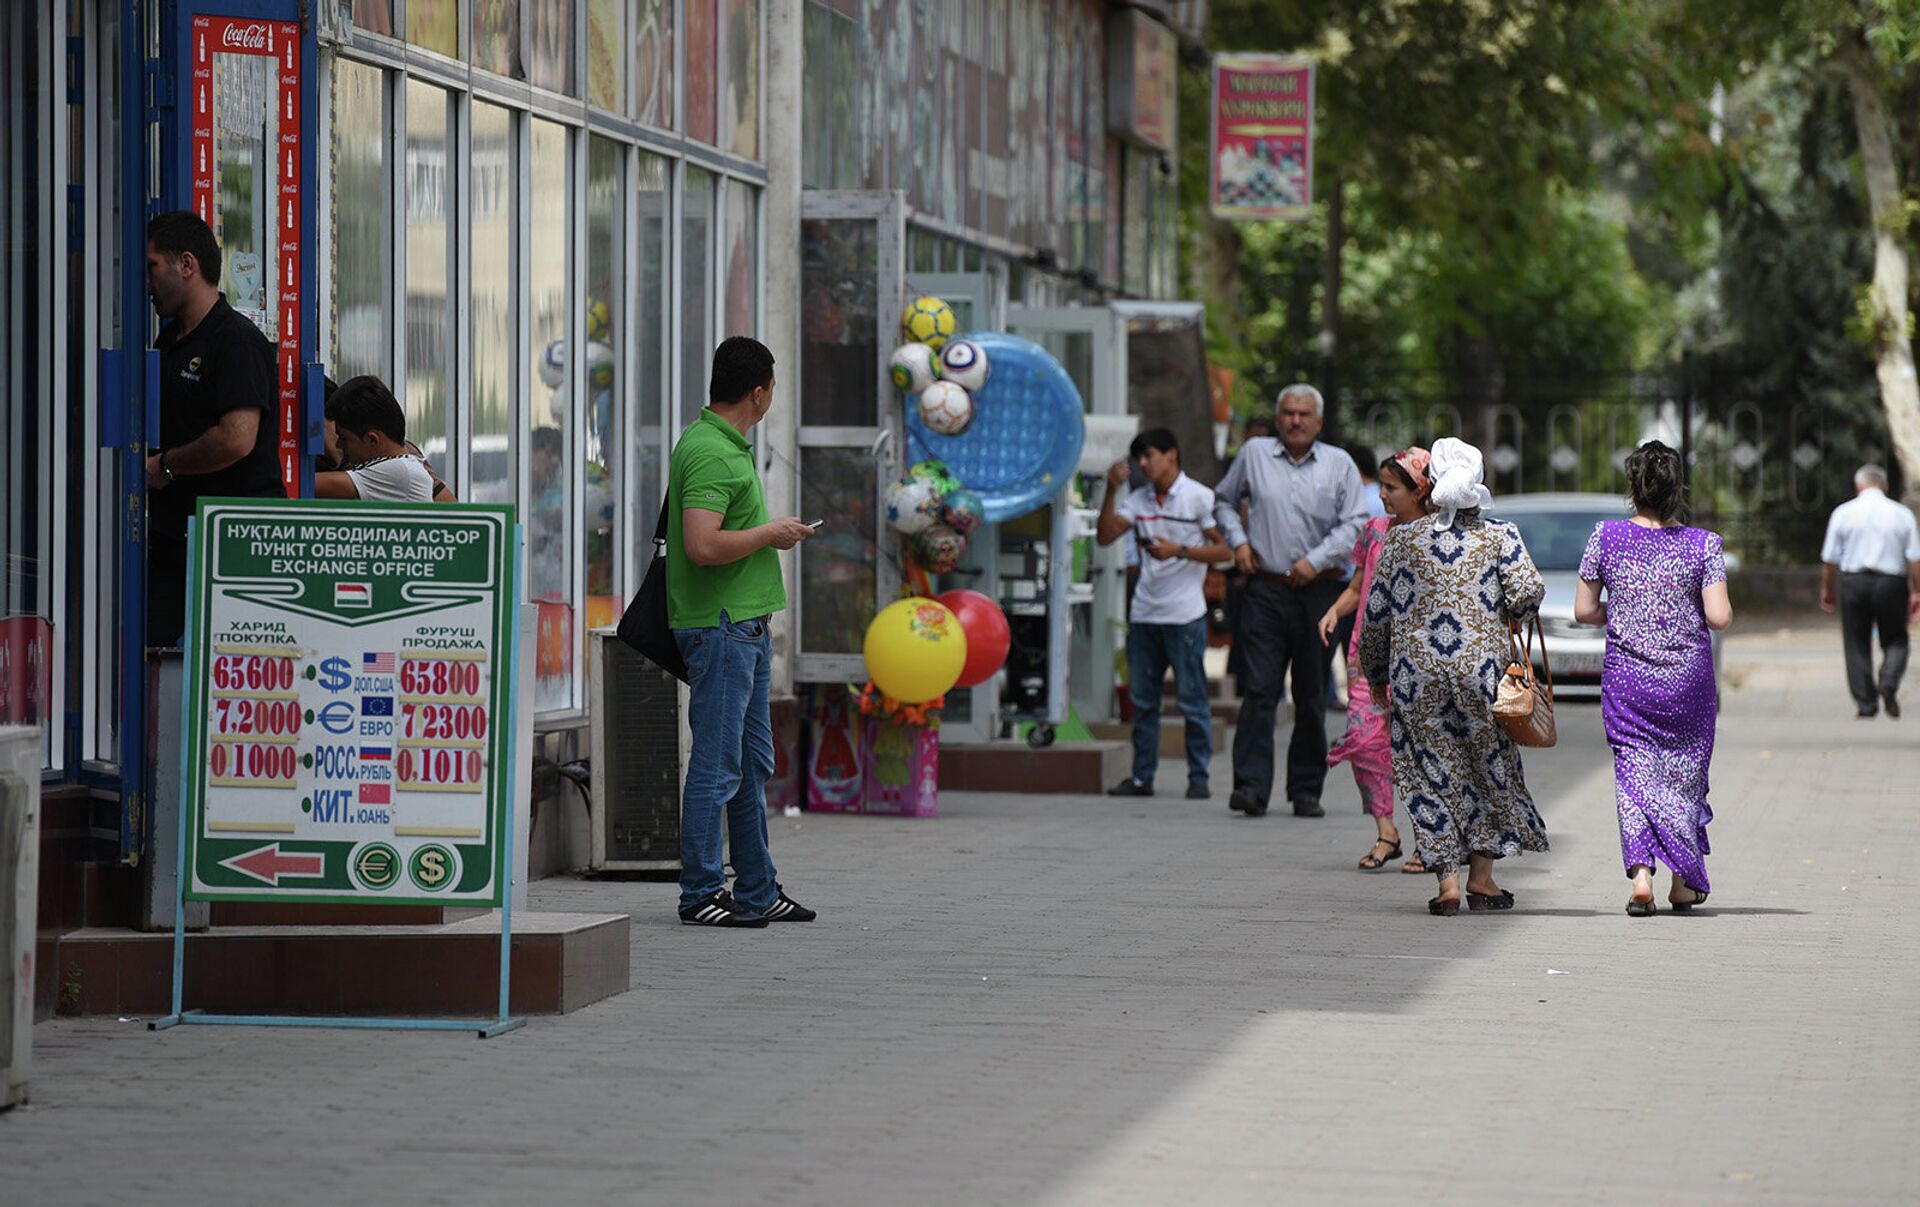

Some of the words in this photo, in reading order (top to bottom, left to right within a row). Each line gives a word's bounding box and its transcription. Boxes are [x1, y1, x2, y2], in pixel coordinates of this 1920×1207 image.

[227, 524, 296, 541] НУҚТАИ
[300, 526, 412, 544] МУБОДИЛАИ
[416, 528, 481, 545] АСЪОР
[250, 541, 307, 557] ПУНКТ
[311, 543, 388, 560] ОБМЕНА
[391, 545, 457, 561] ВАЛЮТ
[271, 559, 368, 576] EXCHANGE
[372, 561, 435, 577] OFFICE
[230, 621, 287, 633] ХАРИД
[416, 626, 476, 637] ФУРУШ
[219, 633, 297, 645] ПОКУПКА
[402, 638, 485, 650] ПРОДАЖА
[215, 656, 294, 691] 65600
[400, 659, 480, 696] 65800
[216, 698, 302, 735] 7,2000
[359, 721, 394, 736] ЕВРО
[315, 744, 359, 780] РОСС.
[361, 765, 392, 781] РУБЛЬ
[396, 748, 482, 784] 0,1010
[313, 788, 355, 824] КИТ.
[357, 809, 390, 825] ЮАНЬ
